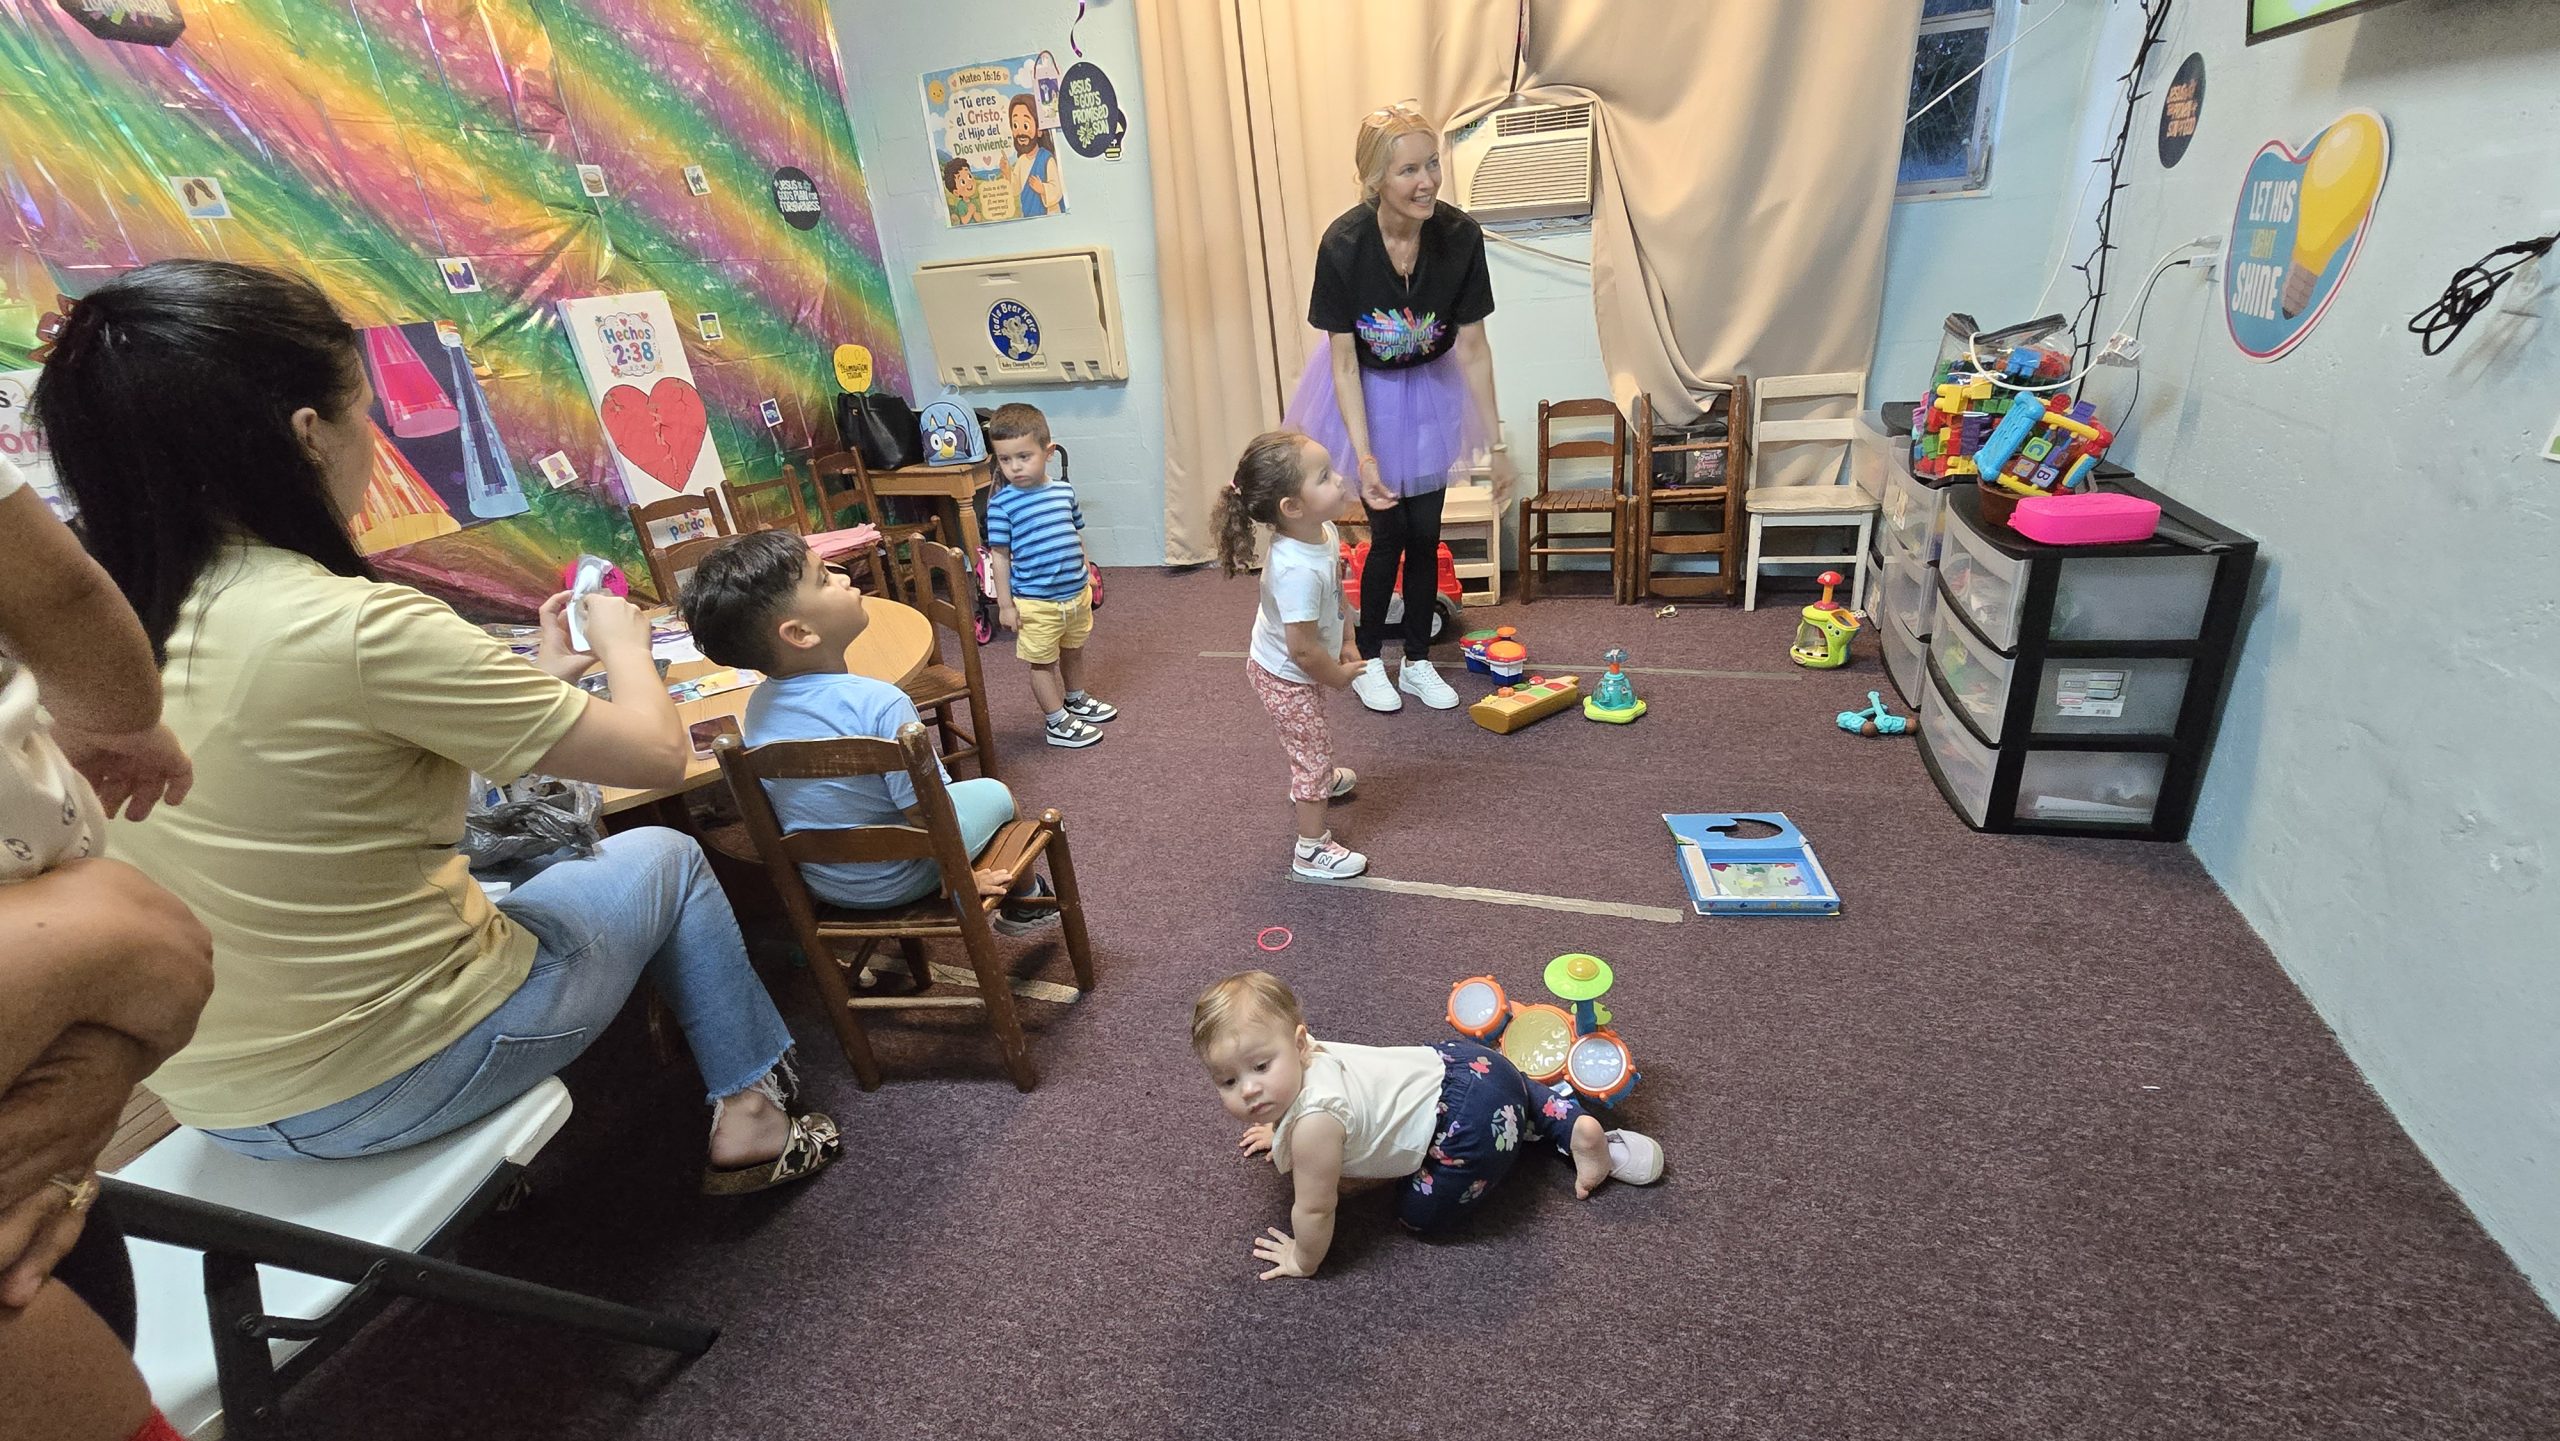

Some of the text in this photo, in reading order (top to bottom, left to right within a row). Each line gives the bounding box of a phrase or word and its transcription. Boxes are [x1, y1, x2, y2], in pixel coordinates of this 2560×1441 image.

[959, 70, 1001, 85] Mateo 16:16
[1069, 77, 1092, 96] JESUS
[975, 95, 997, 107] eres
[1080, 91, 1102, 108] GOD'S
[956, 108, 1003, 127] el Cristo,
[958, 123, 1001, 141] el Hijo del
[1092, 119, 1110, 135] SON
[953, 143, 974, 156] Dios
[778, 179, 798, 191] JESUS
[2249, 179, 2298, 224] LET HIS
[2231, 261, 2283, 321] SHINE
[991, 303, 1037, 336] Koala Bear Kare
[603, 326, 651, 344] Hechos
[612, 341, 655, 366] 2:38
[2036, 469, 2051, 481] B
[1318, 854, 1332, 866] N
